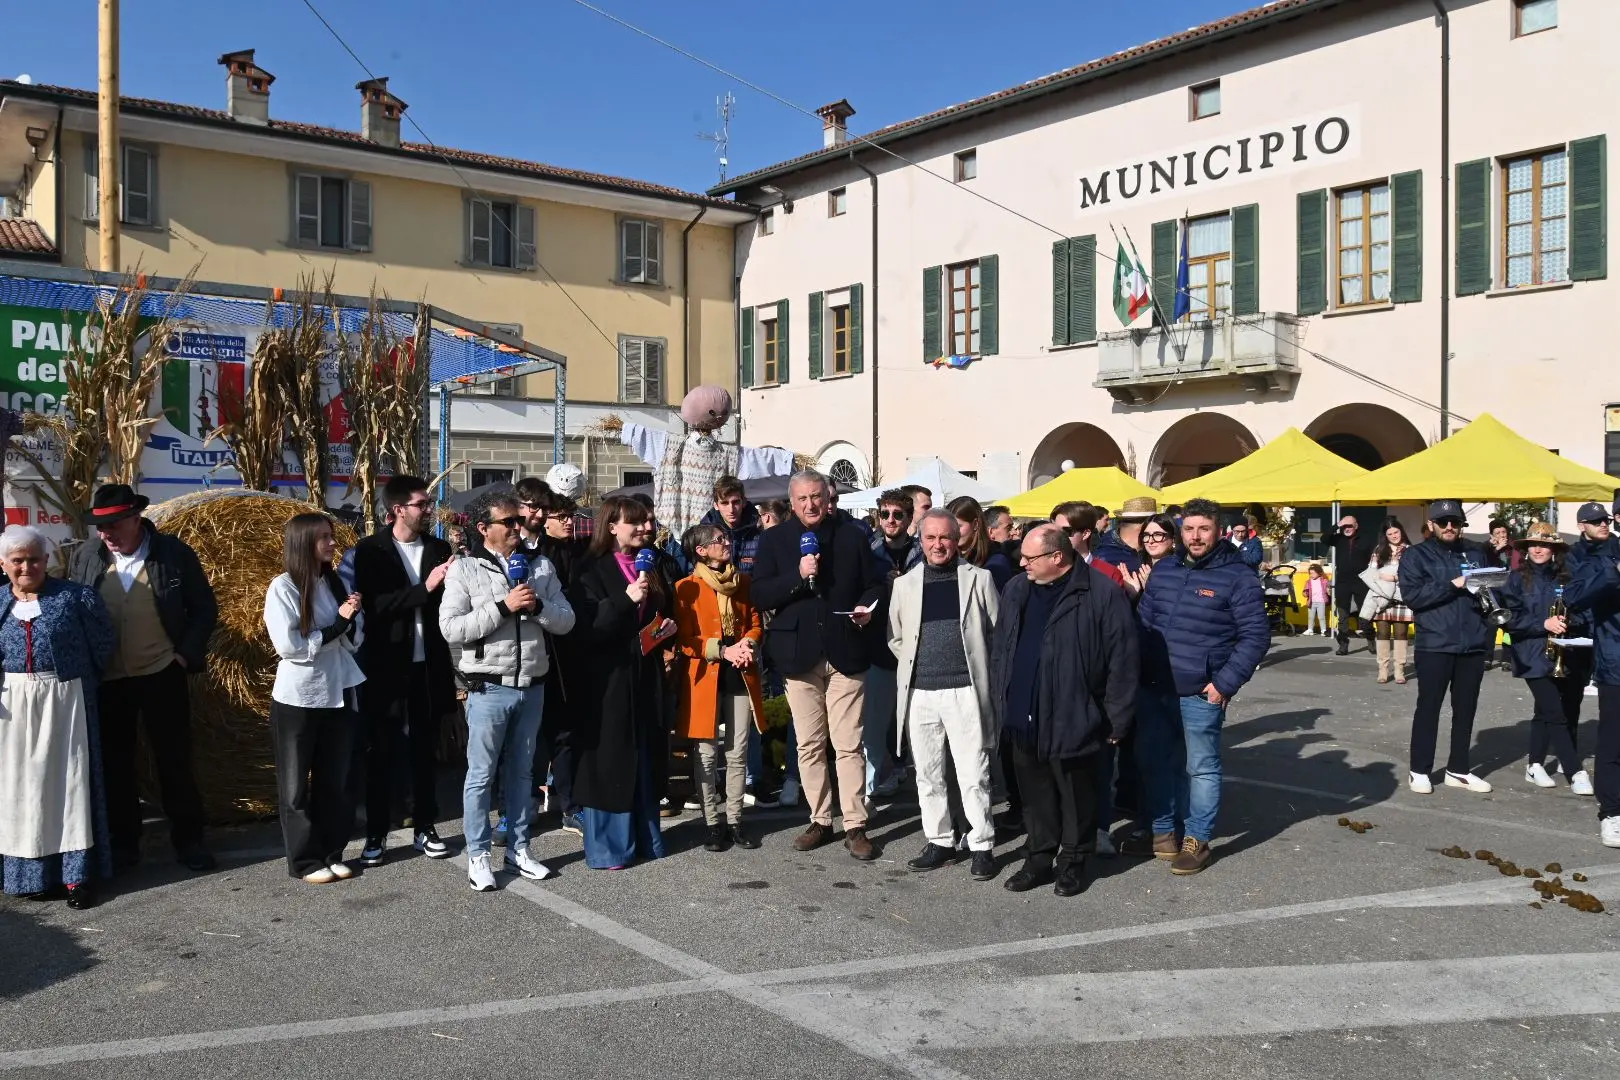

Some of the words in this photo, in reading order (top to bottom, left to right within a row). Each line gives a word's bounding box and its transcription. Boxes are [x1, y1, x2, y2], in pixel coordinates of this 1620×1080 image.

[1080, 117, 1350, 208] MUNICIPIO
[164, 335, 245, 359] Cuccagna
[228, 339, 244, 347] della
[174, 448, 235, 465] ITALIA
